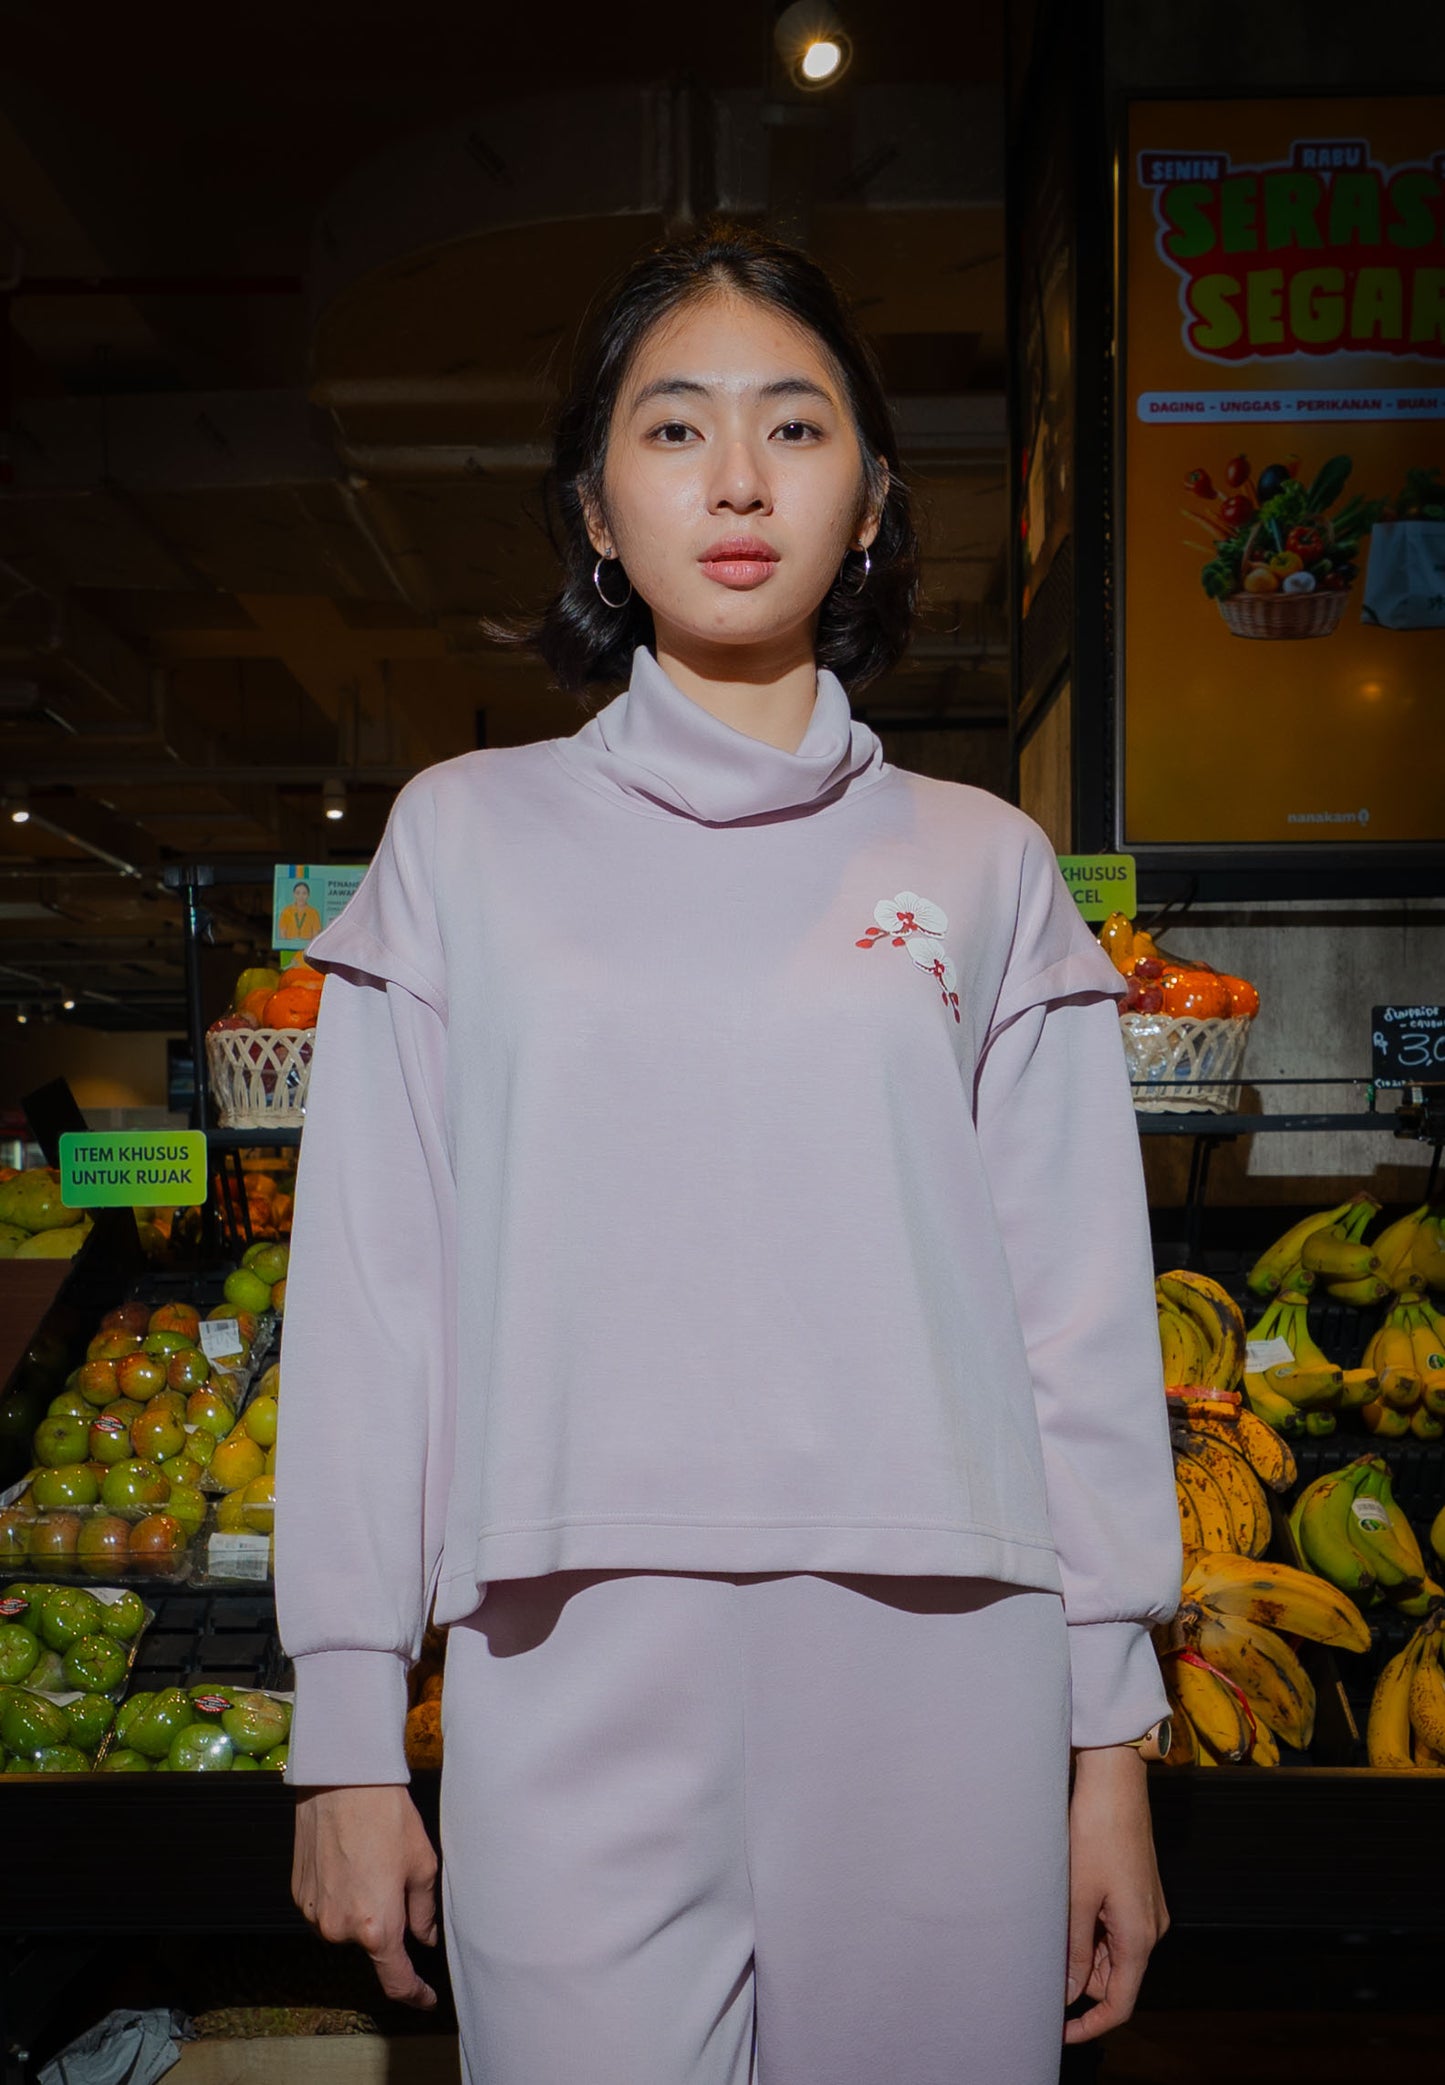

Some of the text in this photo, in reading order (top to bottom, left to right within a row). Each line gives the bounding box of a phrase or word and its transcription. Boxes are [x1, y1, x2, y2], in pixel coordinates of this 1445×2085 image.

[1303, 148, 1360, 168] RABU
[1151, 160, 1219, 181] SENIN
[1165, 172, 1445, 258] SERAS
[1149, 401, 1205, 413] DAGING
[1220, 400, 1281, 412] UNGGAS
[1297, 398, 1381, 411] PERIKANAN
[1397, 398, 1437, 410] BUAH
[74, 1146, 189, 1162] ITEM KHUSUS
[72, 1169, 192, 1185] UNTUK RUJAK
